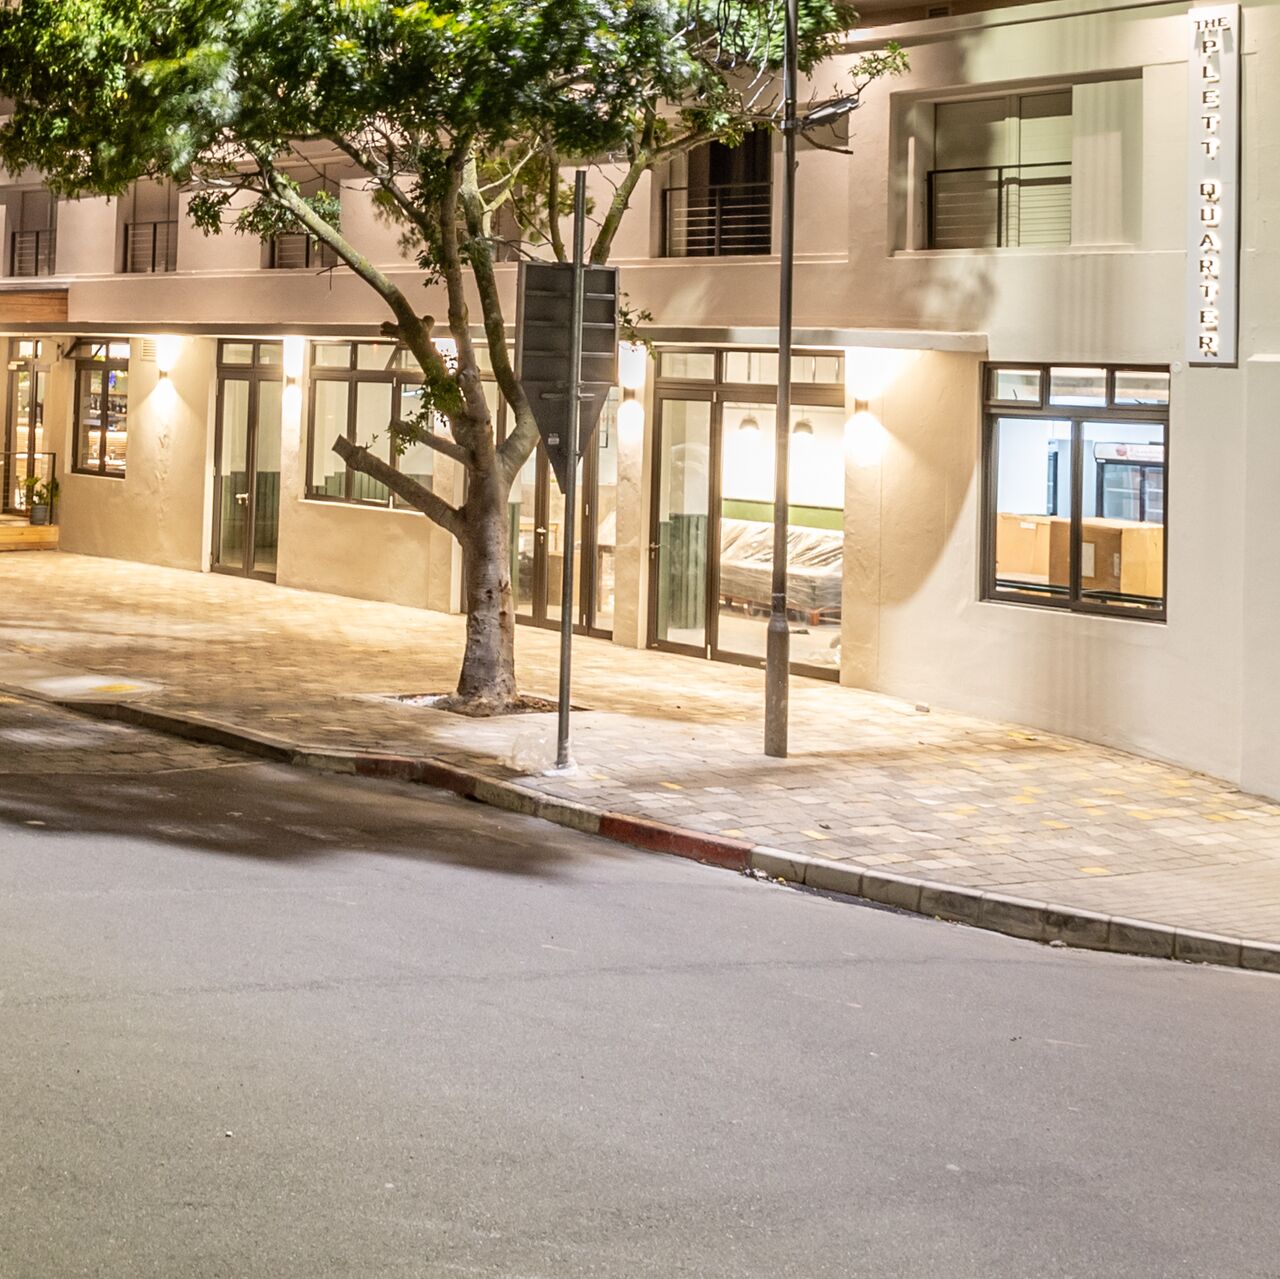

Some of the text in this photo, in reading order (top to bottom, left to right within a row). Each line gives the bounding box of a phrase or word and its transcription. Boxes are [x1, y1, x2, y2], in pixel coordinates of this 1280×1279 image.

[1194, 16, 1231, 358] THE PLETT QUARTER
